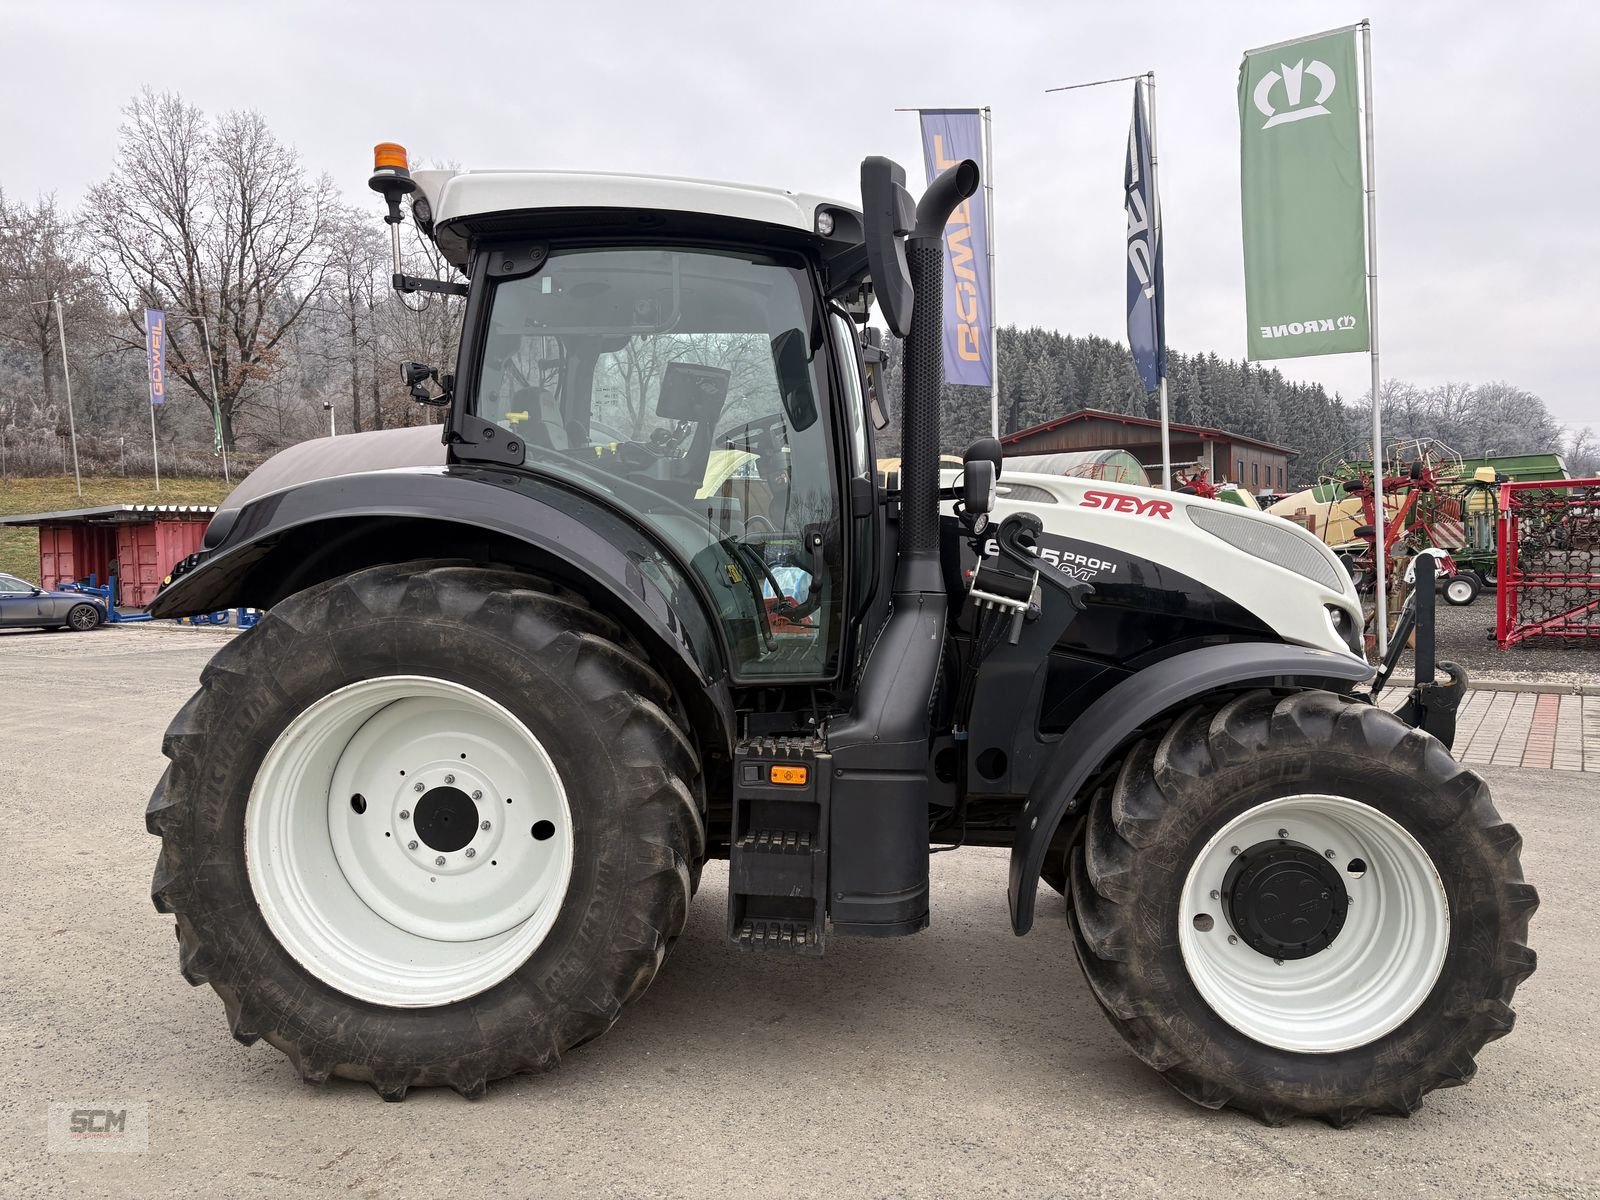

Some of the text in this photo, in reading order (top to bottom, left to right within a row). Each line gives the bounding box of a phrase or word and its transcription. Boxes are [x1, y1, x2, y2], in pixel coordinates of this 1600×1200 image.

[1079, 490, 1173, 520] STEYR
[984, 538, 1117, 574] 65 PROFI
